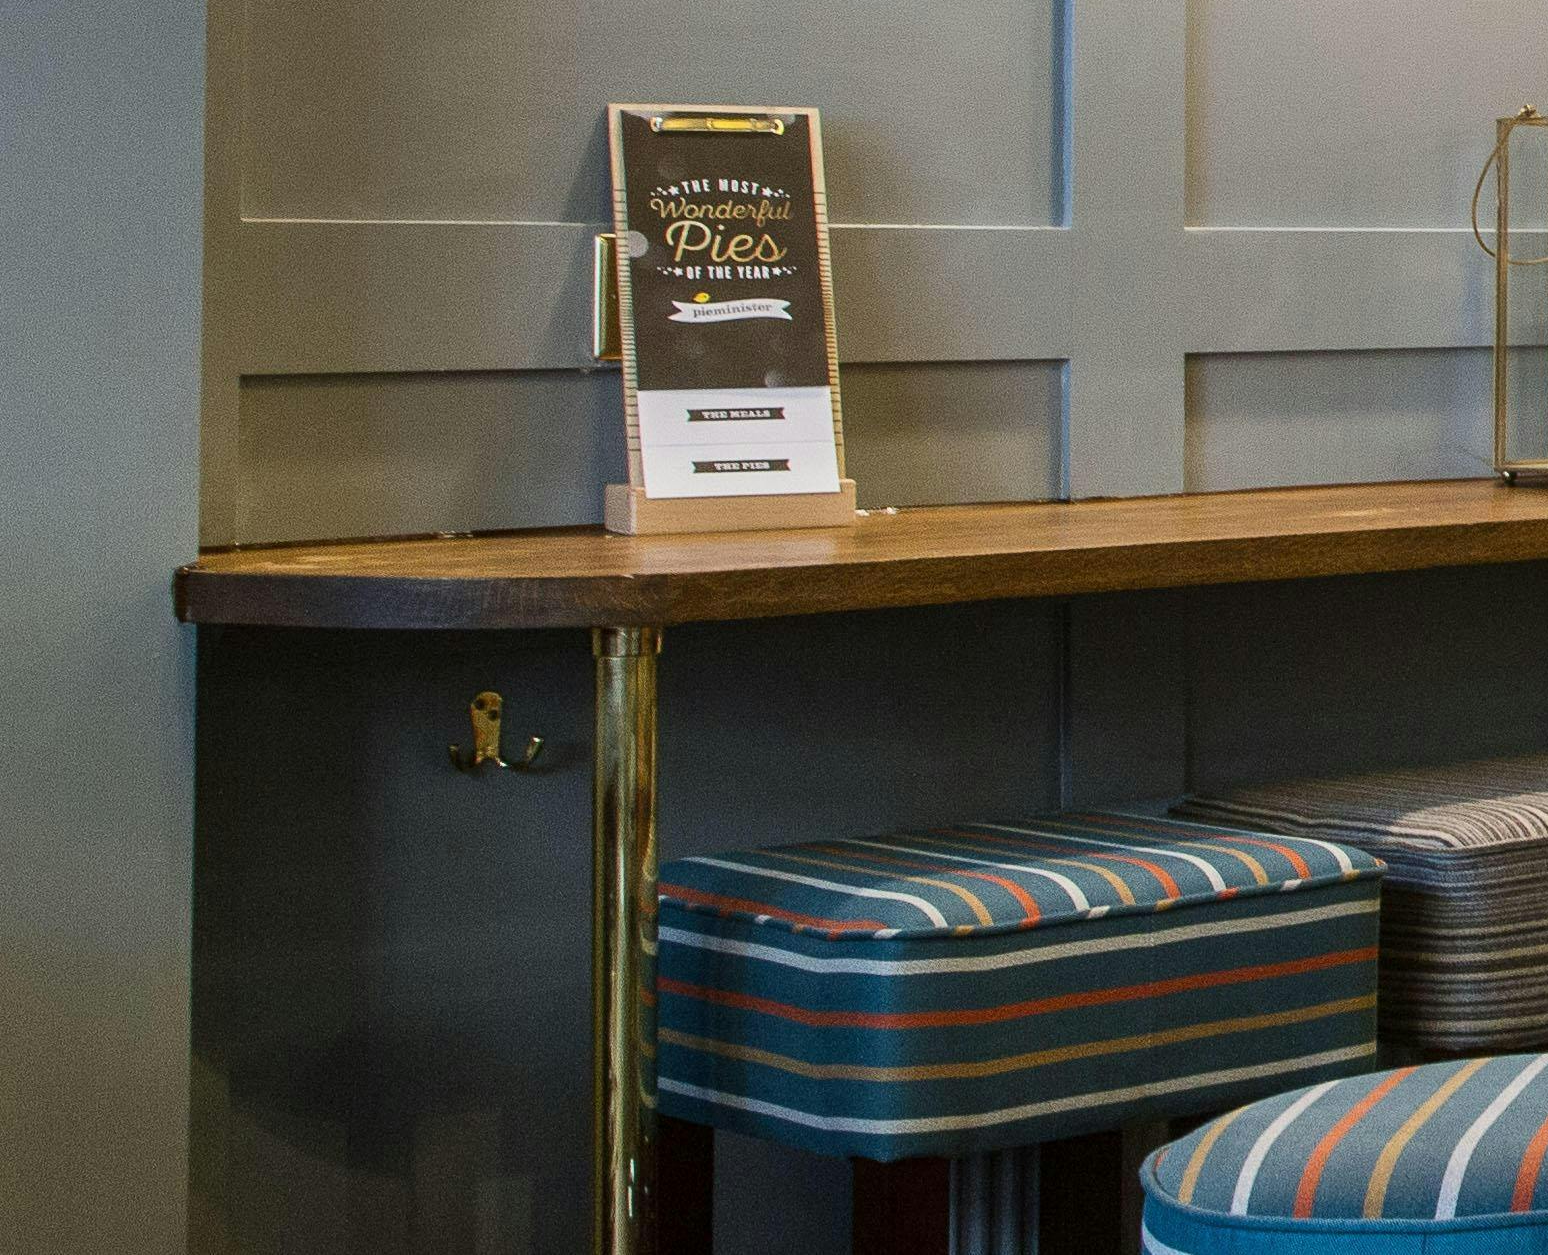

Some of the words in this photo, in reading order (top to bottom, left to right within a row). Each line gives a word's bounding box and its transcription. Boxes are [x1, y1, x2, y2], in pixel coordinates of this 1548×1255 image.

[681, 178, 711, 194] THE
[718, 178, 760, 195] MOST
[650, 197, 792, 227] Wonderful
[666, 220, 787, 262] Pies
[686, 265, 702, 280] OF
[707, 265, 732, 280] THE
[737, 265, 770, 280] YEAR
[693, 303, 773, 318] pieminister
[701, 411, 727, 420] THE
[729, 409, 771, 418] MEALS
[714, 462, 740, 471] THE
[741, 461, 770, 470] PIES
